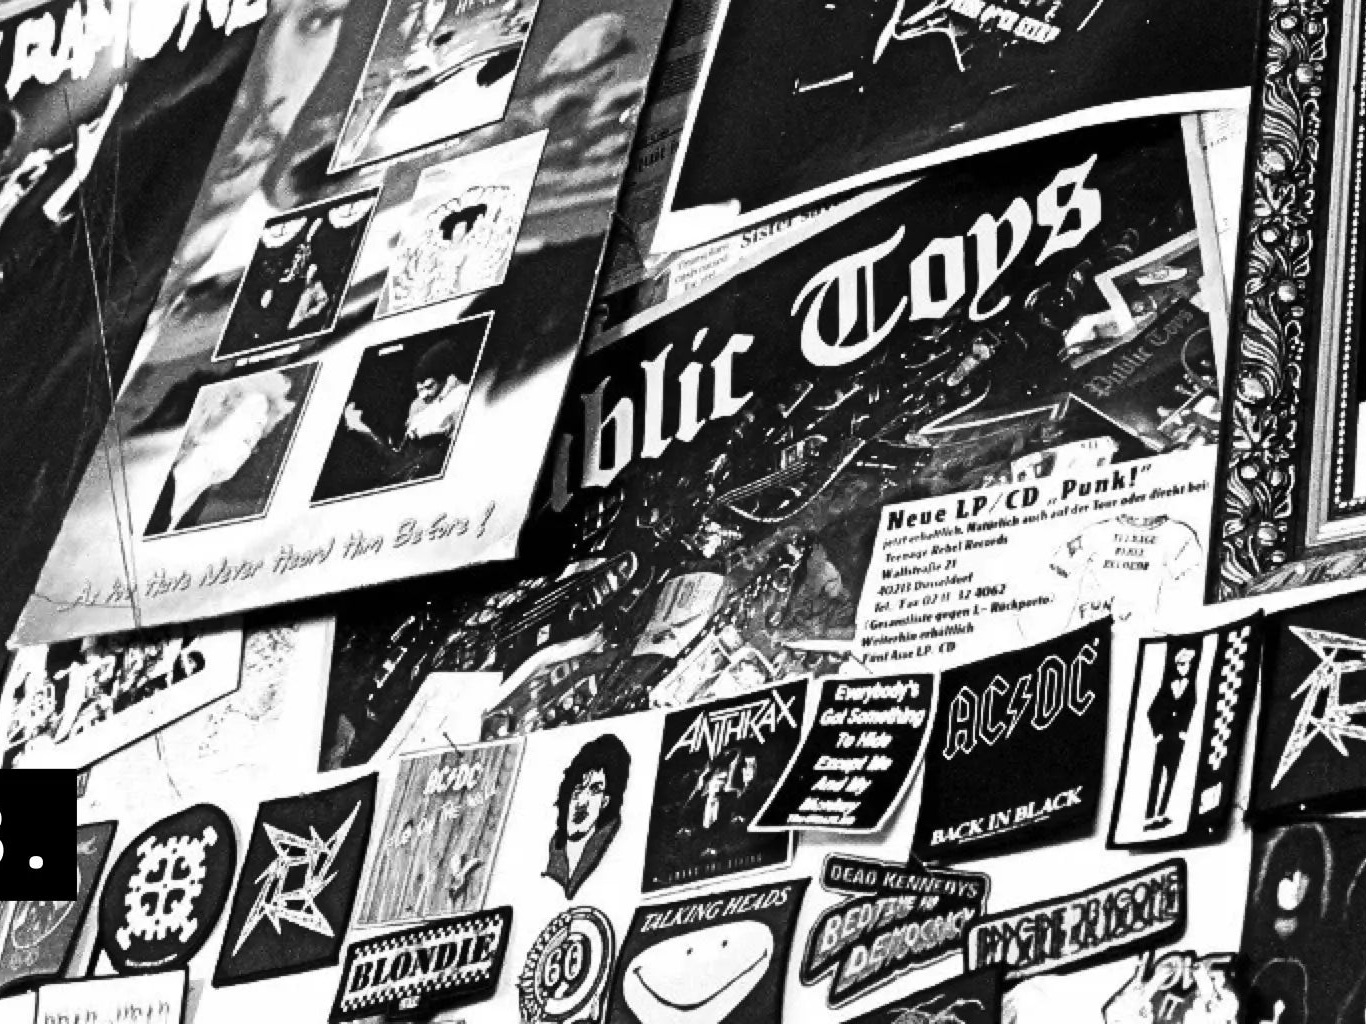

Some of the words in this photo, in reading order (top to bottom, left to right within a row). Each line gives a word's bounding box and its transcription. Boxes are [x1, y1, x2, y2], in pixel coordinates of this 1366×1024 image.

[792, 154, 1102, 367] Toys
[887, 510, 945, 530] Neue
[957, 487, 1039, 518] LP/CD
[1023, 510, 1047, 524] auch
[1149, 486, 1185, 500] direkt
[965, 534, 1007, 550] Records
[145, 572, 191, 598] Have
[199, 559, 263, 588] Never
[273, 538, 335, 575] Heard
[343, 533, 383, 560] Him
[834, 679, 920, 705] Everybody's
[664, 687, 798, 766] ANTHRAX
[820, 707, 848, 726] Got
[847, 705, 926, 728] Something
[836, 731, 856, 748] To
[855, 731, 893, 748] Hide
[810, 776, 849, 792] And
[813, 755, 869, 774] Except
[866, 755, 894, 771] Me
[798, 797, 862, 814] Monkey
[931, 816, 987, 847] BACK
[988, 810, 1011, 830] IN
[1014, 786, 1082, 822] BLACK
[830, 864, 878, 886] DEAD
[884, 869, 980, 899] KENNEDYS
[641, 900, 727, 932] TALKING
[723, 886, 791, 916] HEADS
[820, 896, 917, 952] BEDTIME
[846, 907, 977, 969] DEMOCRACY
[349, 939, 497, 993] BLONDIE
